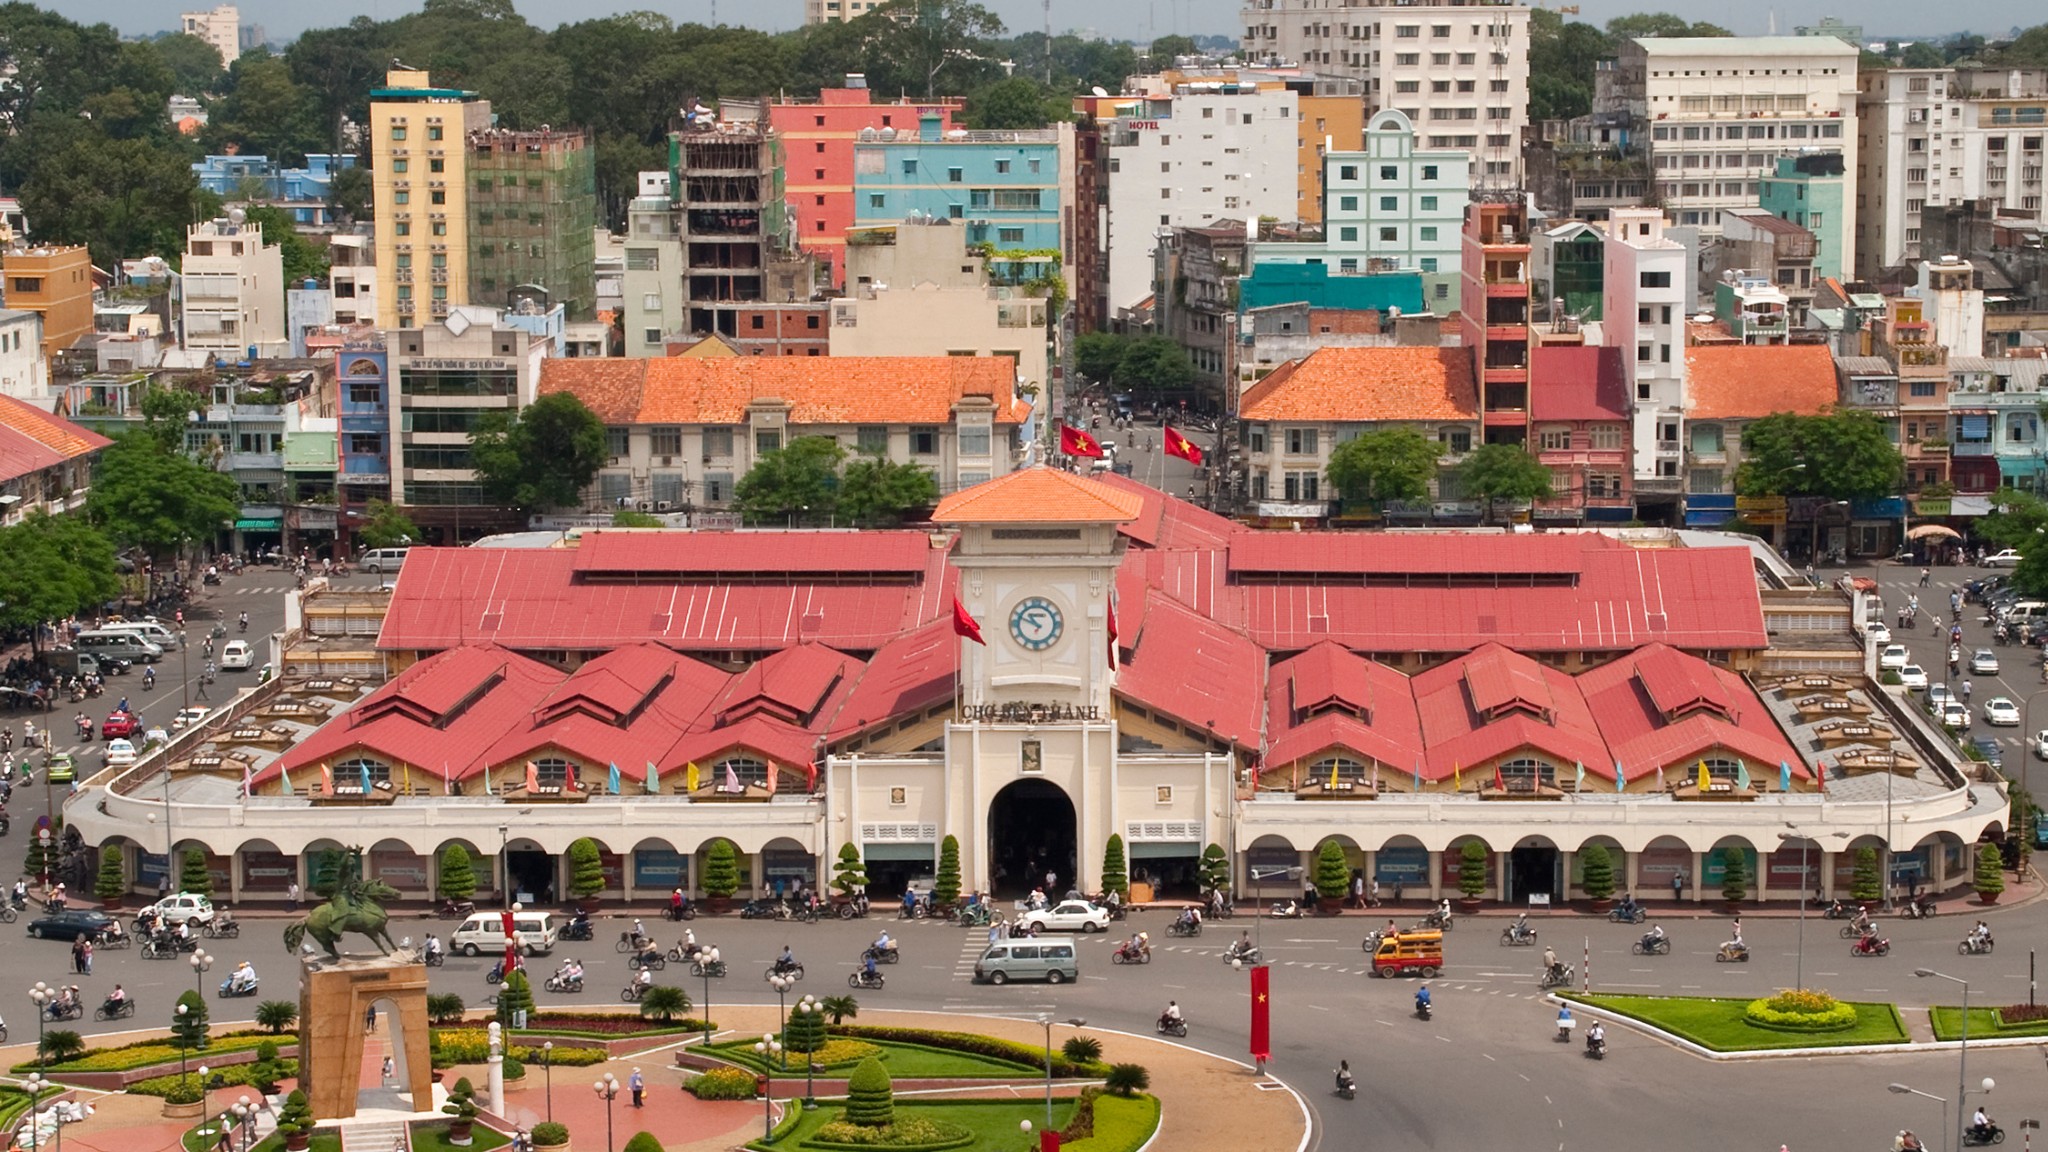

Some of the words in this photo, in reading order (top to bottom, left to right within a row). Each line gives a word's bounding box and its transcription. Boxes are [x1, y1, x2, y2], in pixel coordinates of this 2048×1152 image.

[1129, 121, 1160, 130] HOTEL
[962, 703, 996, 719] CHỢ
[1040, 702, 1099, 719] THÀNH
